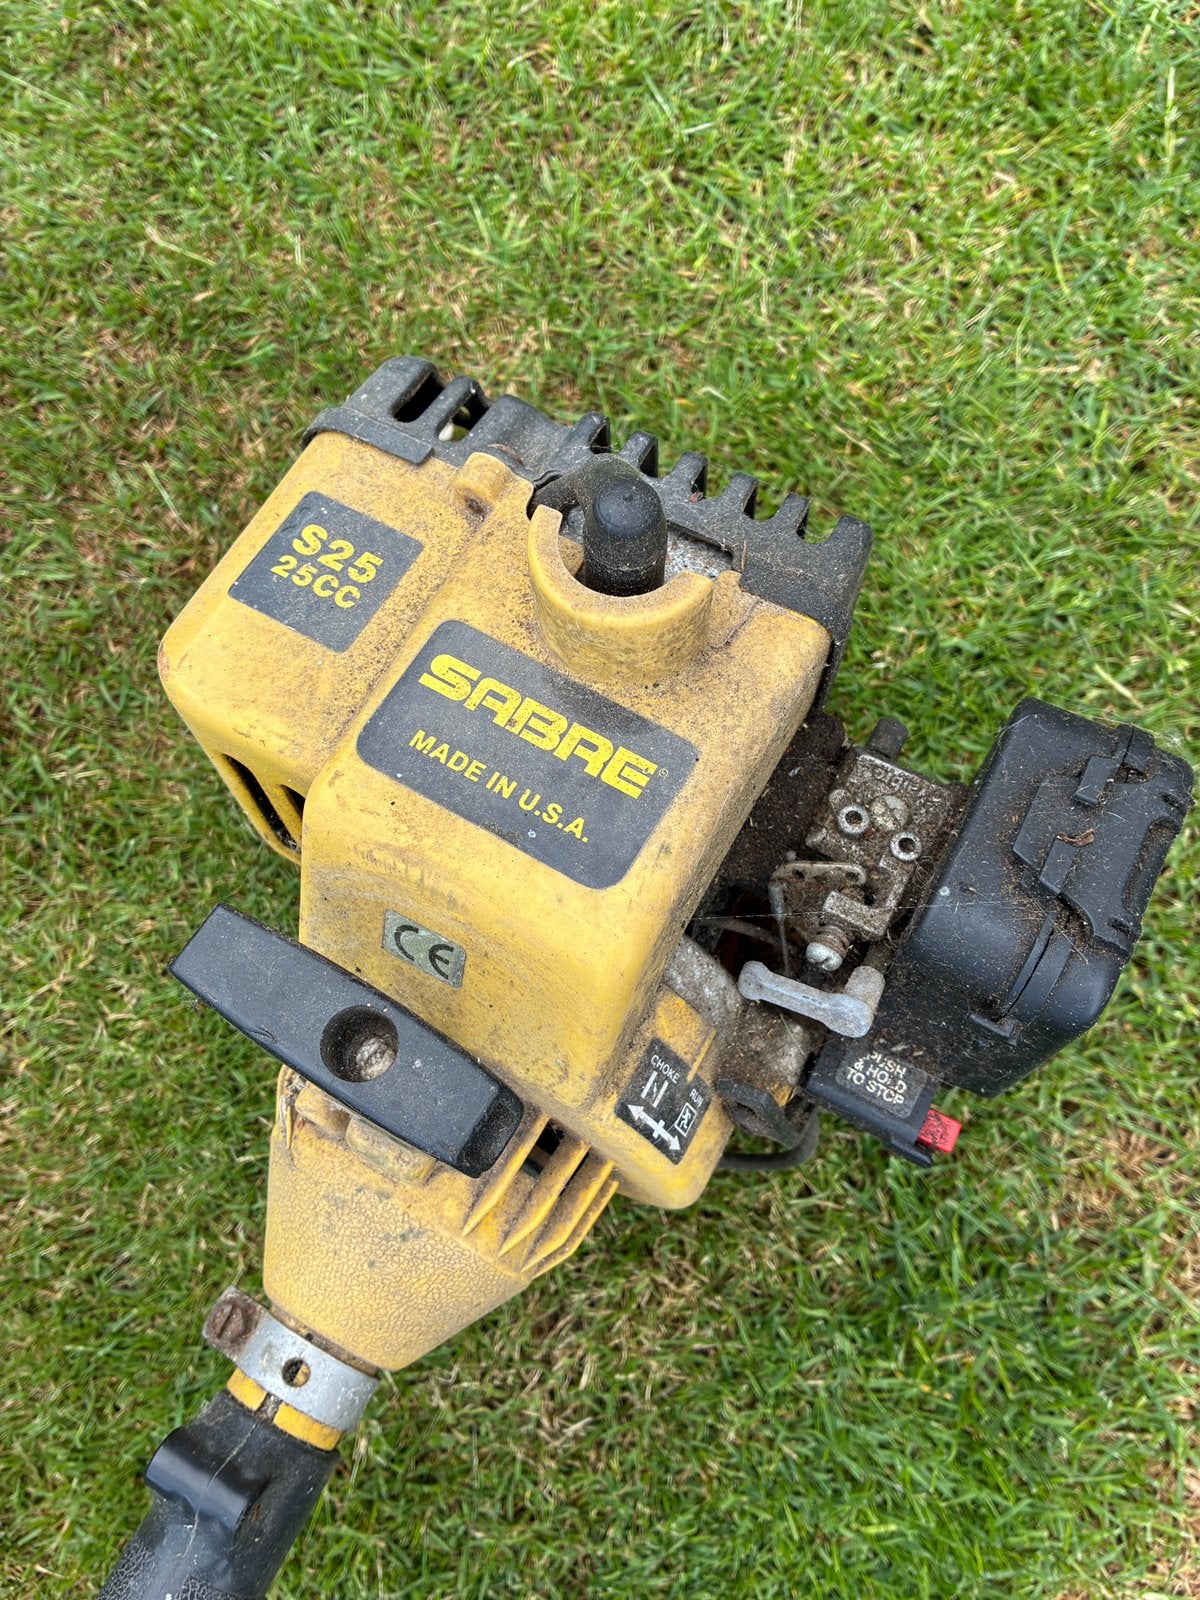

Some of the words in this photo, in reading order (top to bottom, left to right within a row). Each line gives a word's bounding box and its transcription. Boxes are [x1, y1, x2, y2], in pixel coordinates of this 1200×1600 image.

[292, 524, 384, 583] S25
[270, 554, 361, 609] 25CC
[418, 654, 658, 800] SABRE
[408, 729, 487, 783] MADE
[485, 771, 518, 800] IN
[518, 788, 588, 843] U.S.A.
[650, 1054, 681, 1084] CHOKE
[846, 1066, 866, 1085] TO
[865, 1080, 905, 1104] STOP
[689, 1088, 704, 1107] RUN
